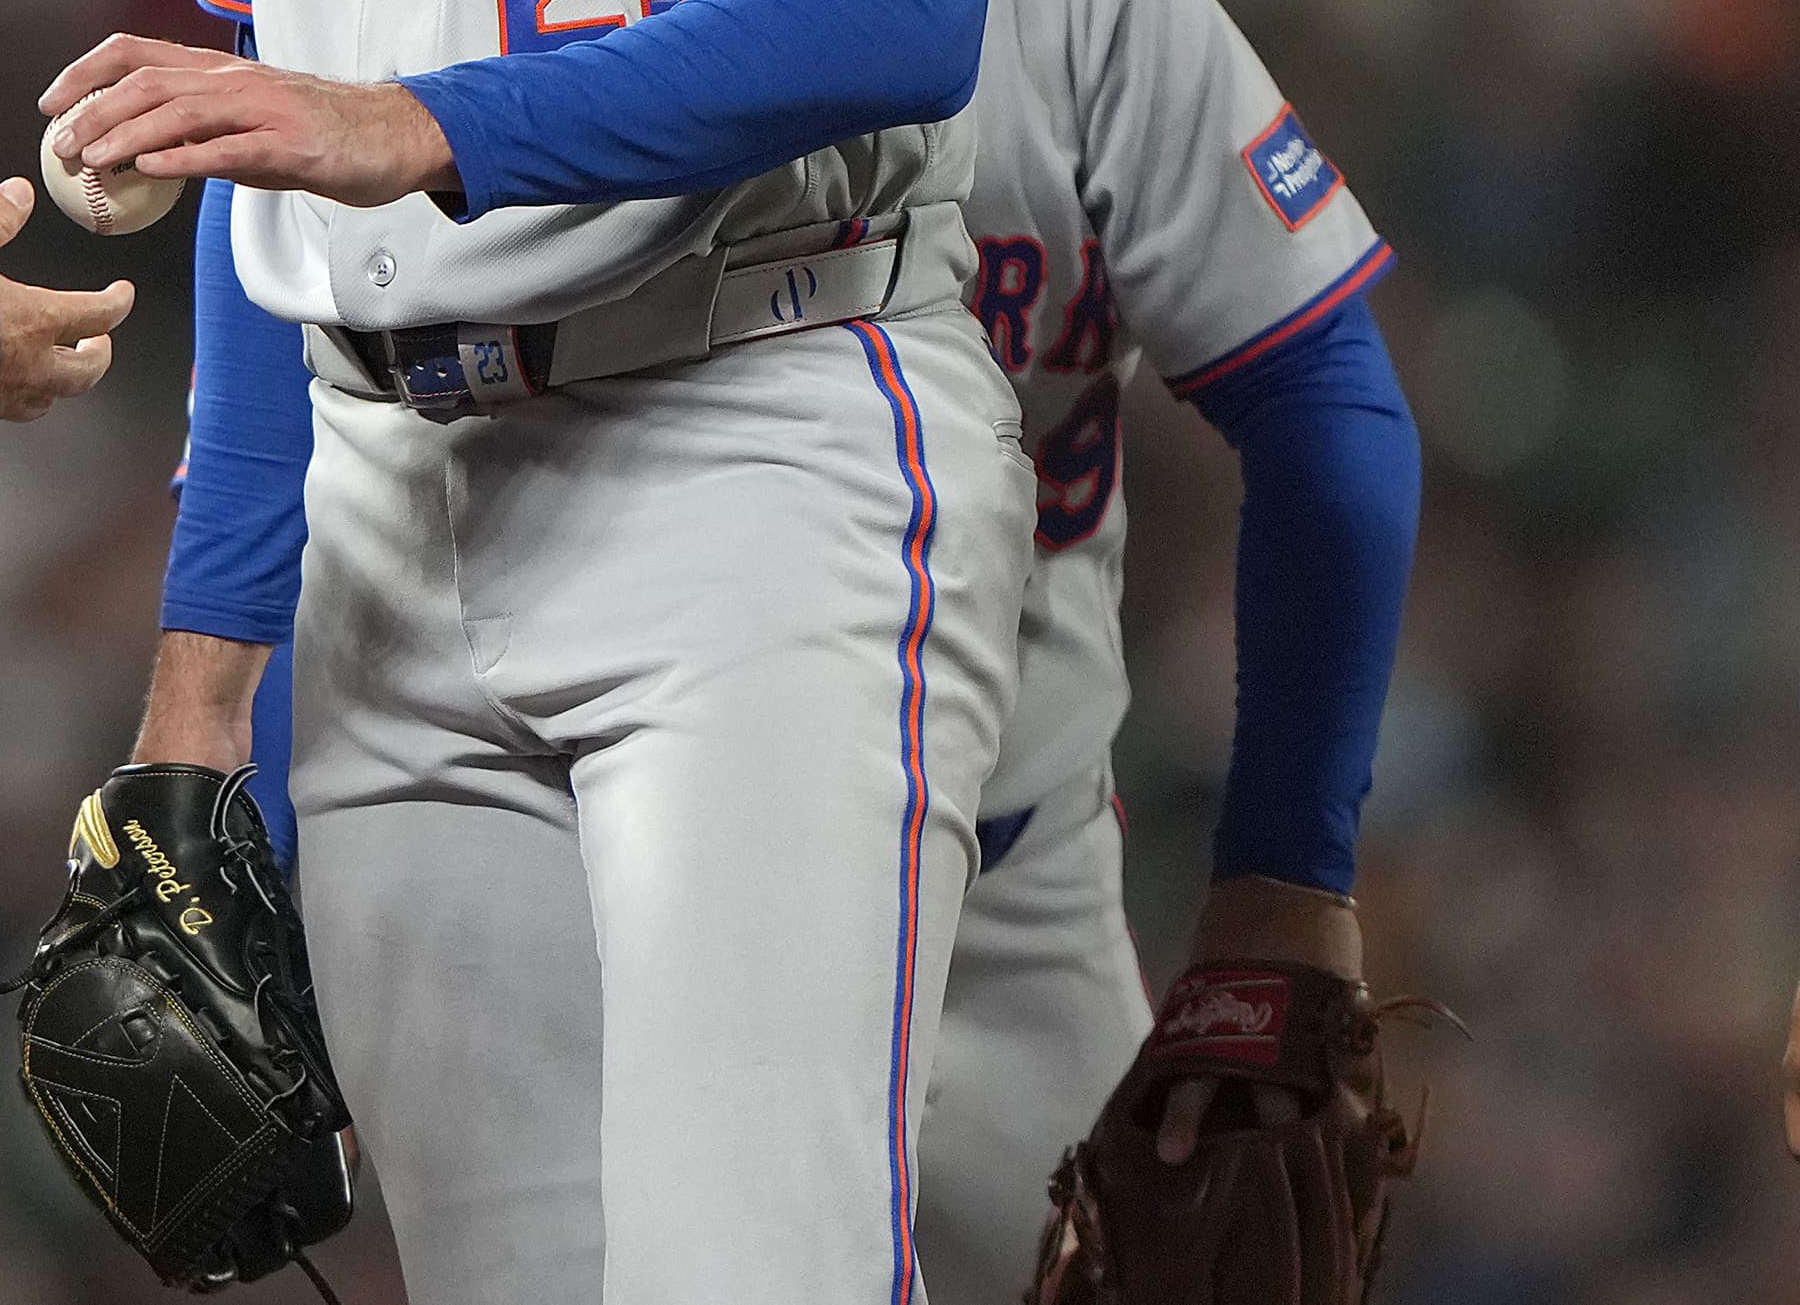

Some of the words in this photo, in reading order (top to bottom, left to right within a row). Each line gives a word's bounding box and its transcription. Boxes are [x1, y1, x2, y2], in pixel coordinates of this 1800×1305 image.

[473, 340, 509, 385] 23
[122, 819, 193, 903] Peterson
[179, 896, 214, 935] D.
